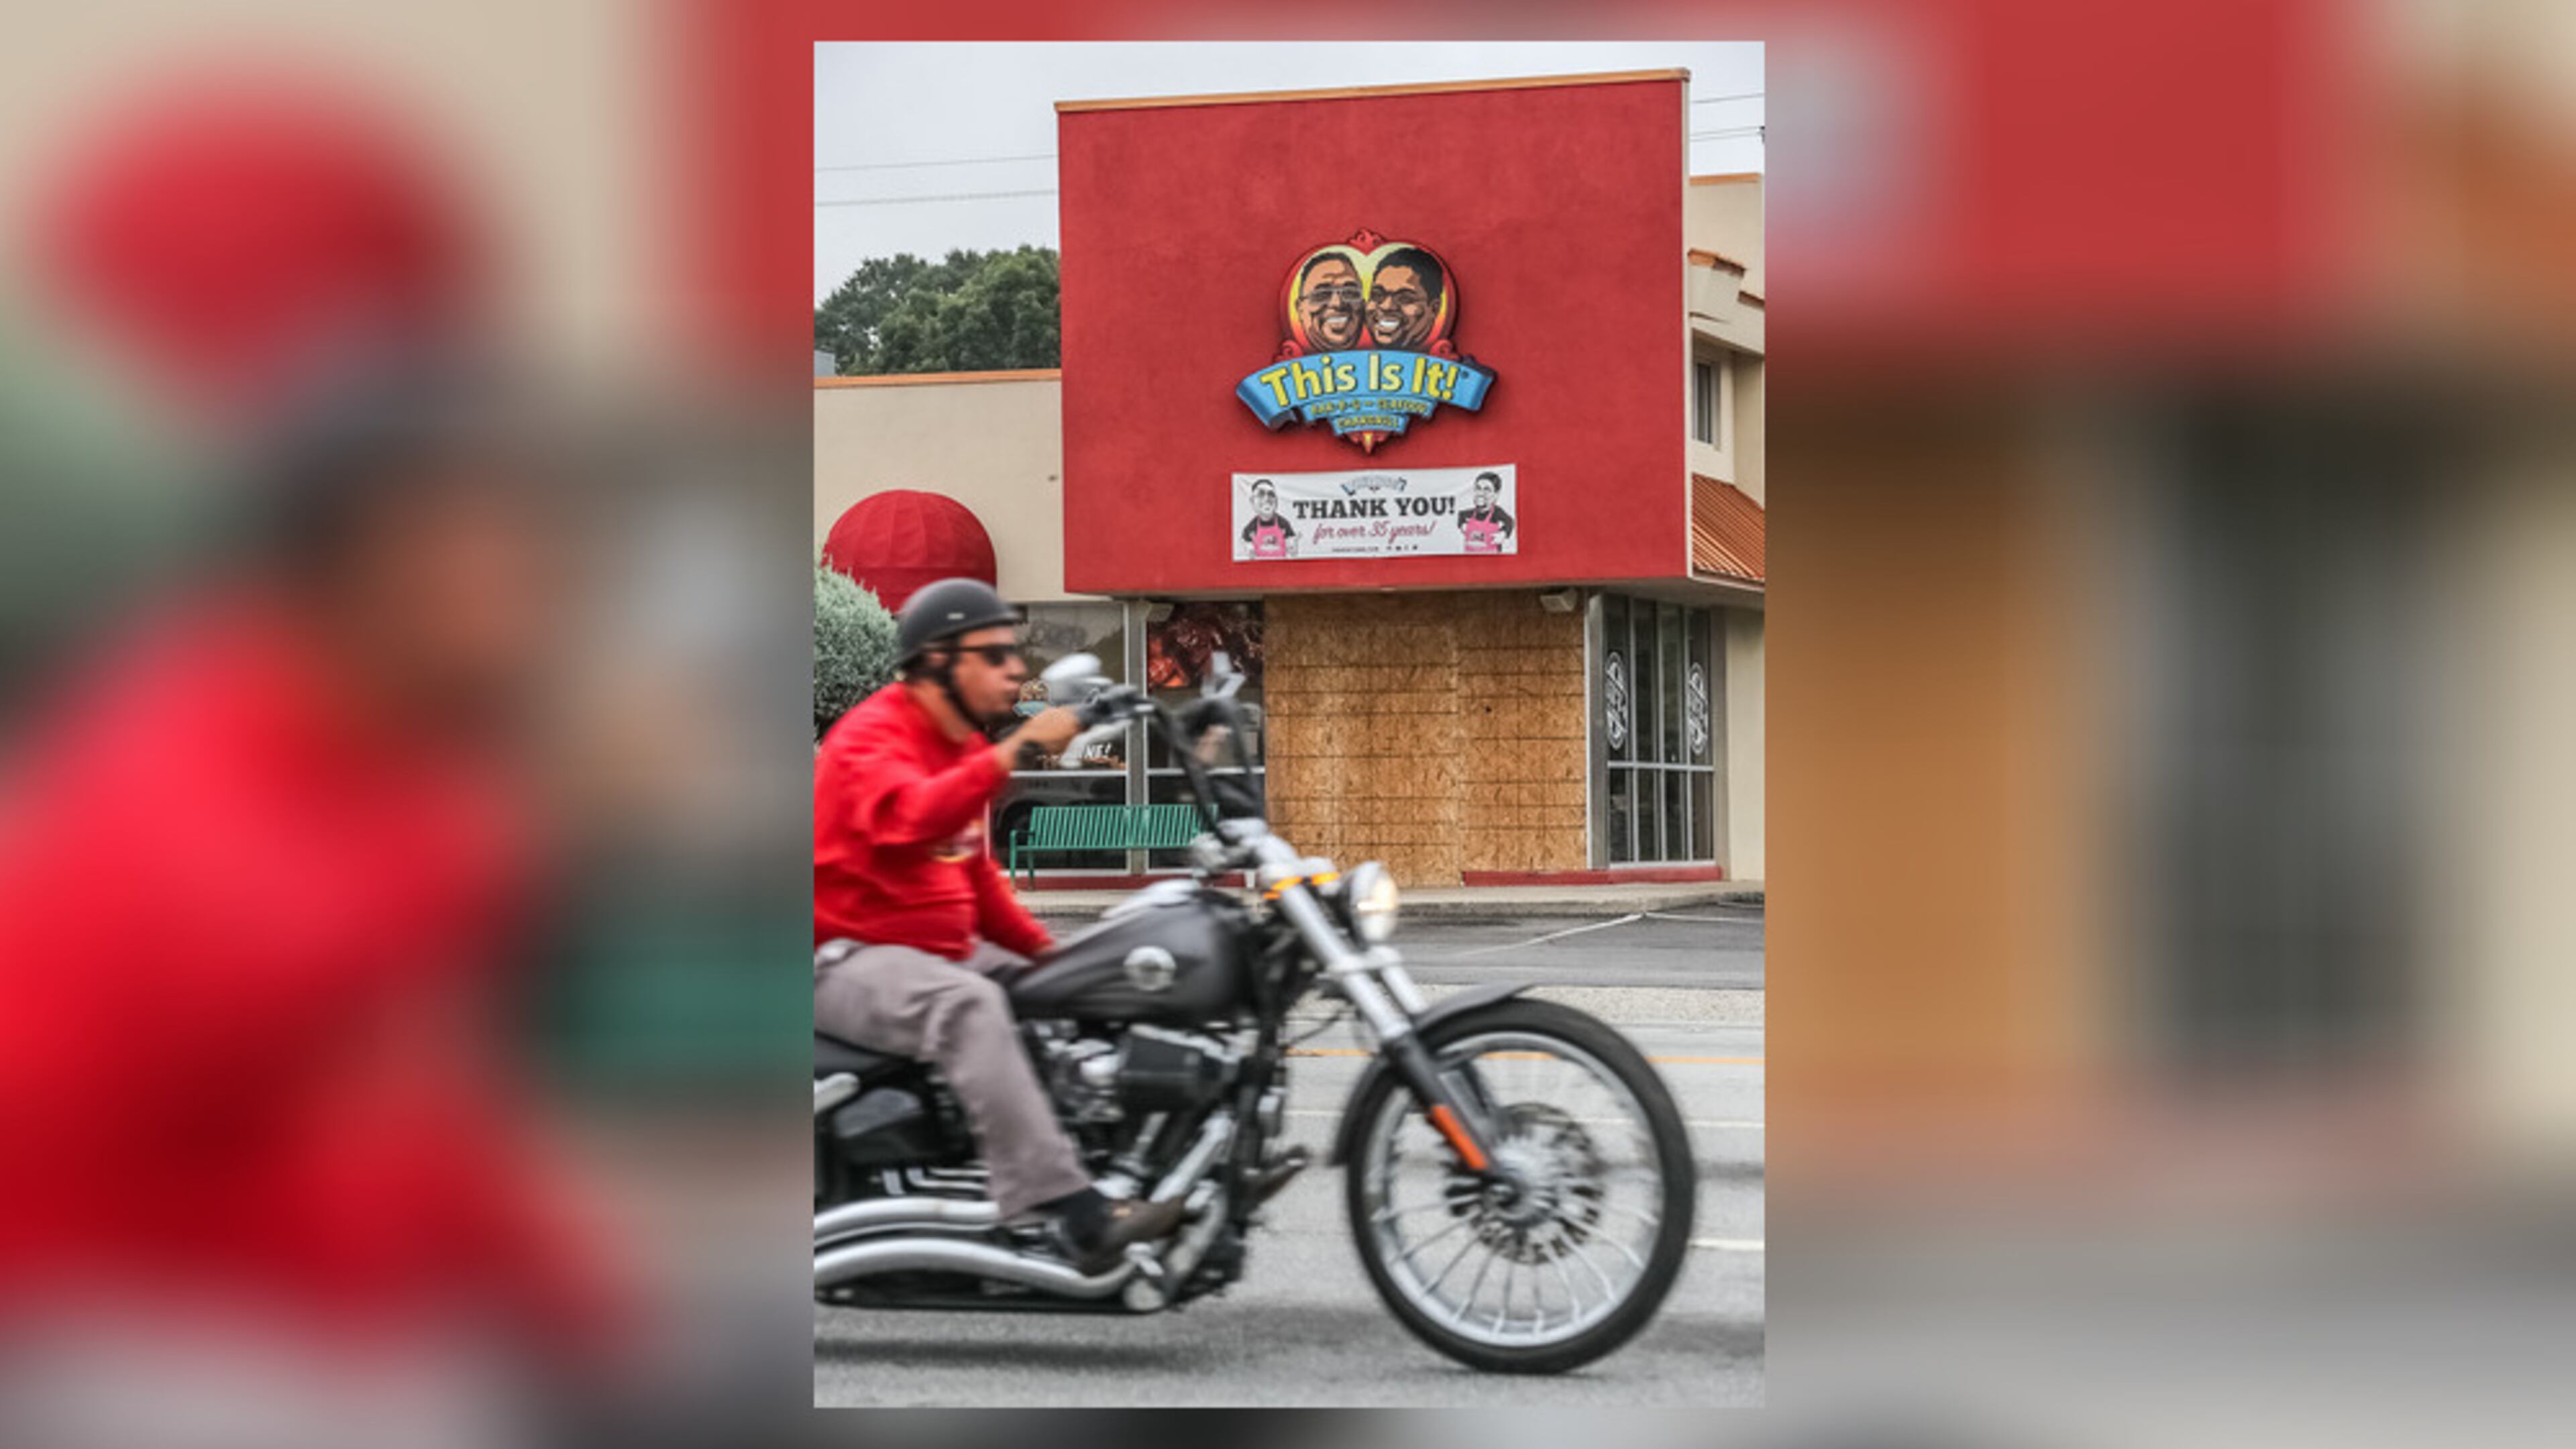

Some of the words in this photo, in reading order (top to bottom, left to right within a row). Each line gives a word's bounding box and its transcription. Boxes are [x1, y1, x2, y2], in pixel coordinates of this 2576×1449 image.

[1259, 355, 1357, 407] This
[1368, 353, 1403, 391] Is
[1411, 356, 1458, 400] It!
[1292, 498, 1389, 519] THANK
[1394, 496, 1456, 517] YOU!
[1313, 523, 1334, 545] for
[1337, 524, 1366, 539] over
[1368, 520, 1391, 537] 35
[1387, 519, 1438, 544] years!
